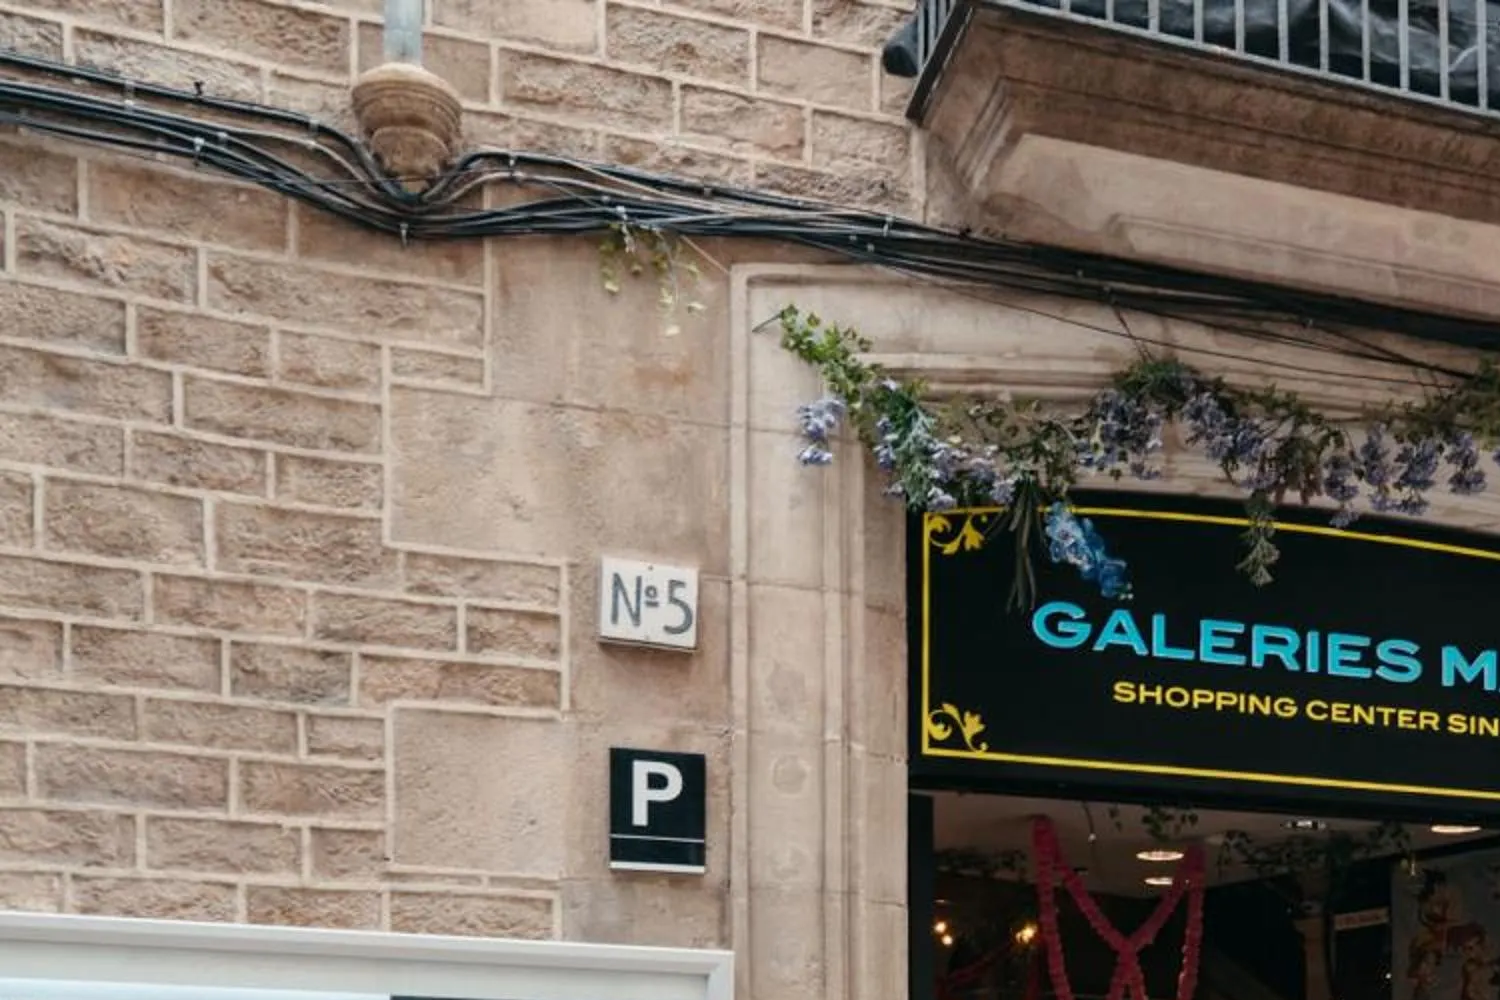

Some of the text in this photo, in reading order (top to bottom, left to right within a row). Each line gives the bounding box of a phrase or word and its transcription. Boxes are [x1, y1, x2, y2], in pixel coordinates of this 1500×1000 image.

[1031, 600, 1423, 683] GALERIES
[1112, 681, 1299, 719] SHOPPING
[1306, 699, 1441, 733] CENTER
[631, 759, 683, 827] P
